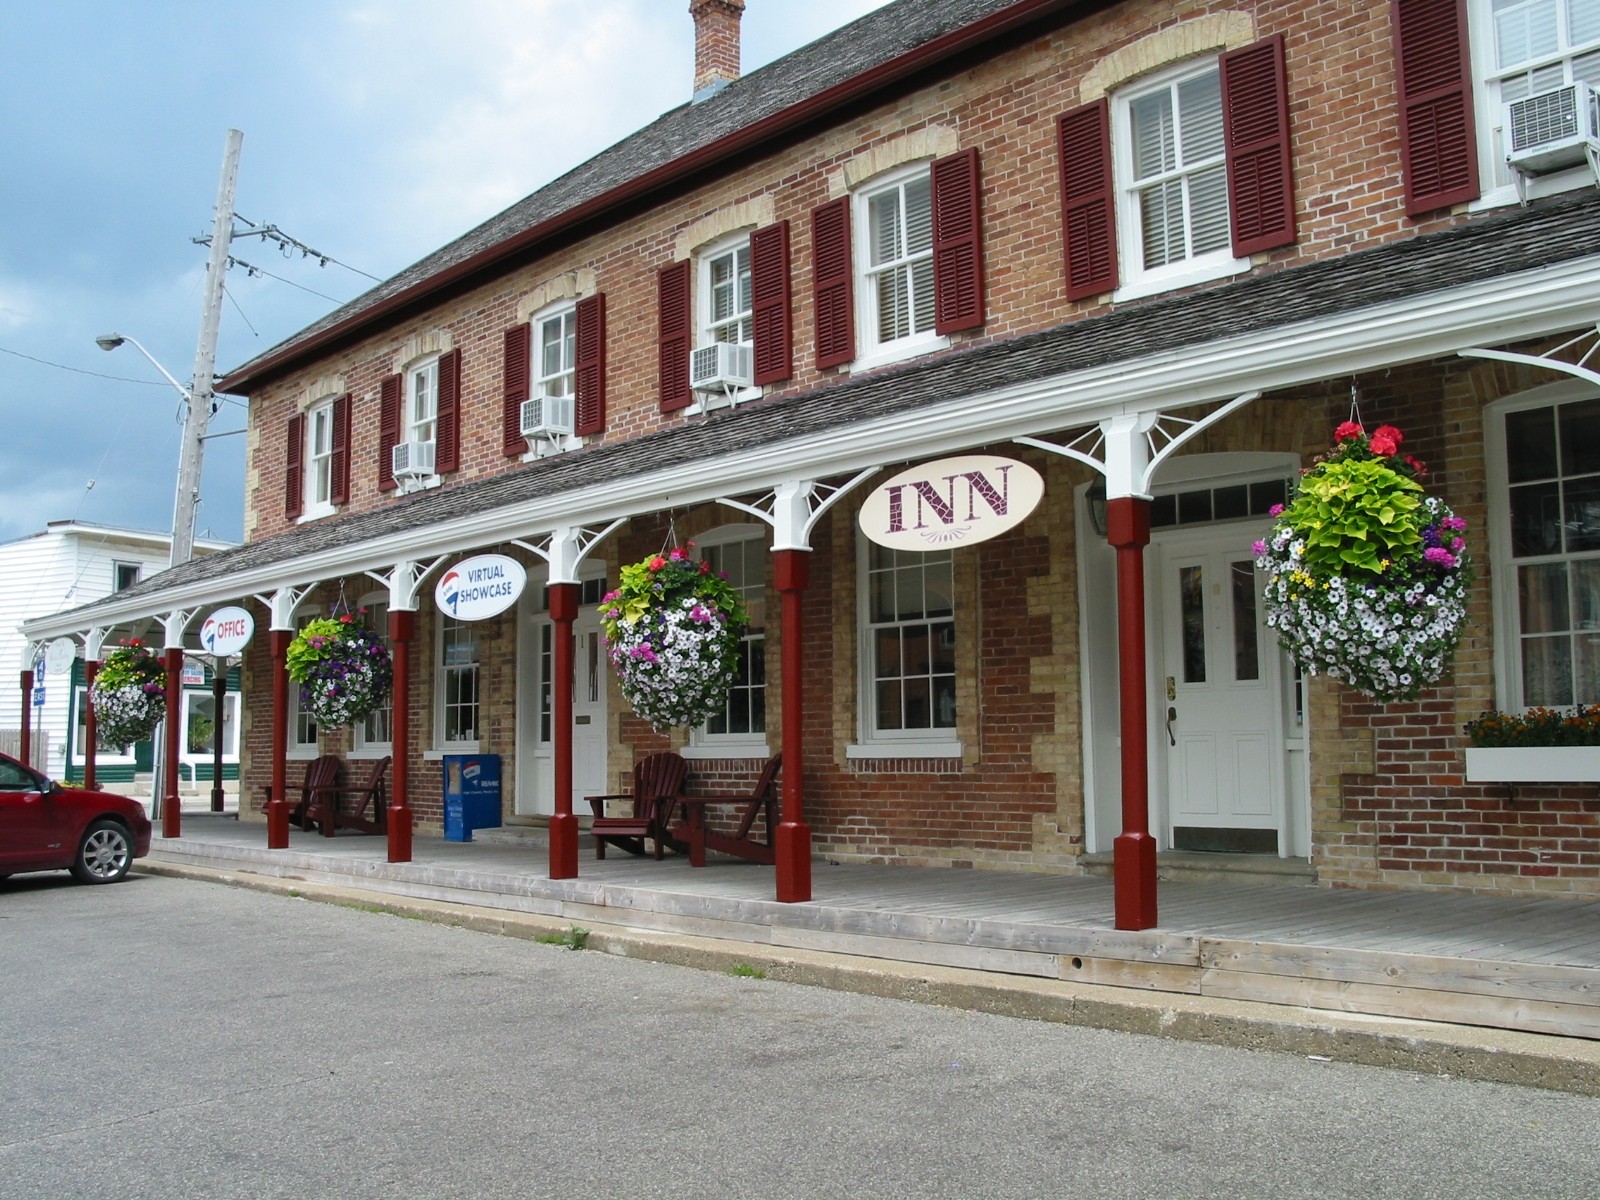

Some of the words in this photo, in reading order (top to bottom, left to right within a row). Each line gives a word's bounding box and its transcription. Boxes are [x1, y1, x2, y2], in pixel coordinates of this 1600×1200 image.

[884, 464, 1013, 534] INN
[468, 564, 504, 583] VIRTUAL
[460, 581, 512, 603] SHOWCASE
[217, 619, 245, 639] OFFICE
[34, 691, 45, 701] EAST
